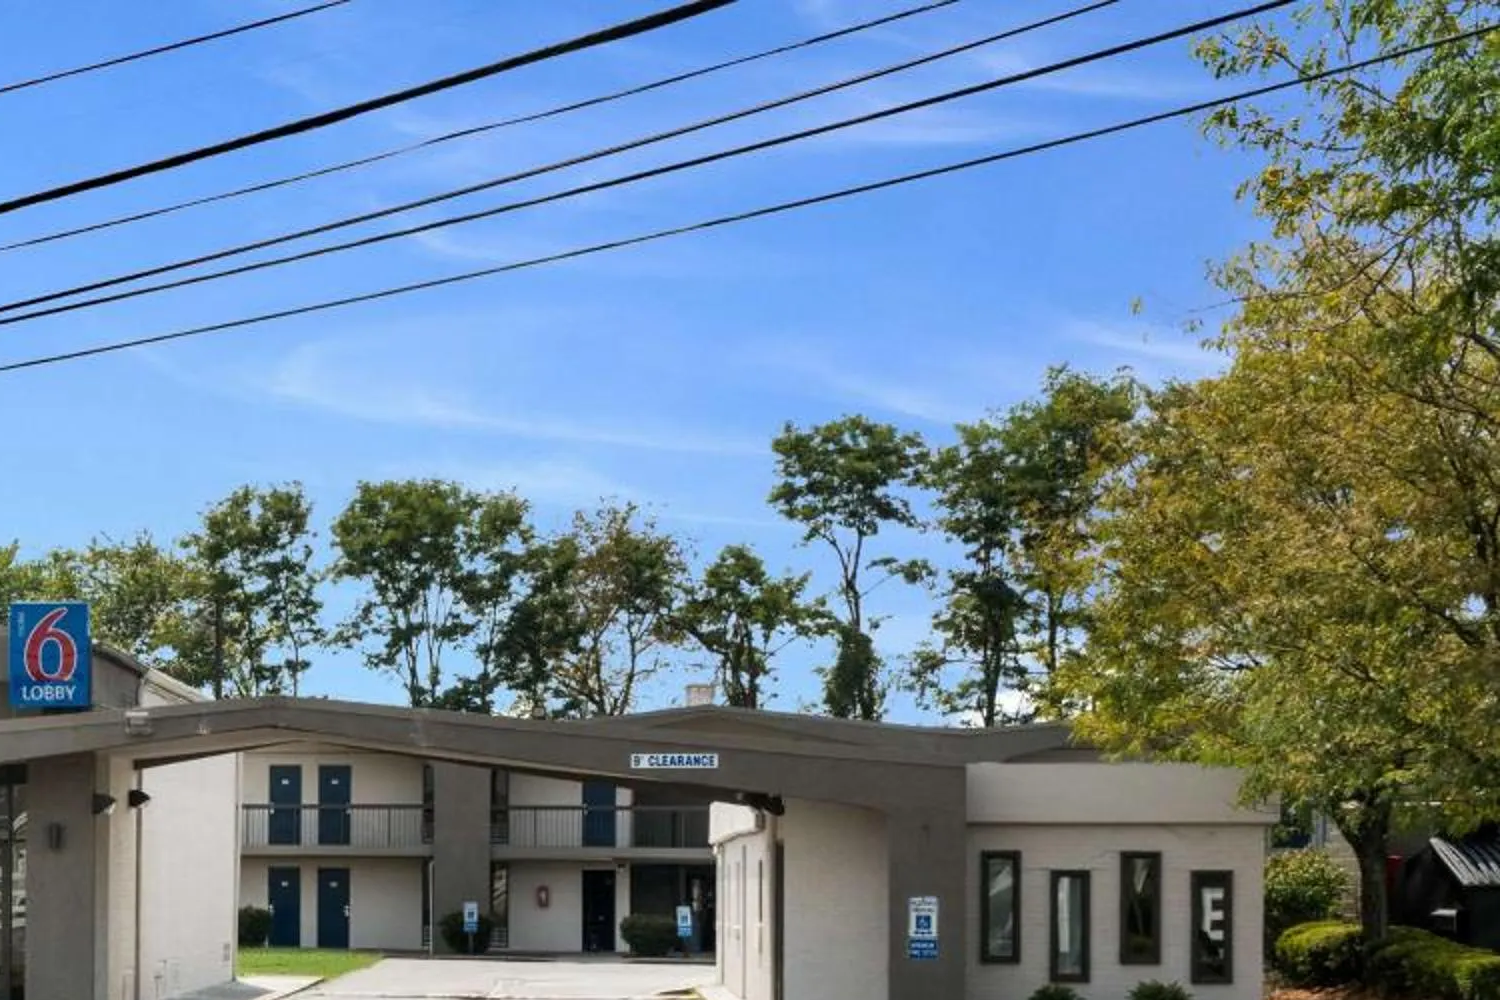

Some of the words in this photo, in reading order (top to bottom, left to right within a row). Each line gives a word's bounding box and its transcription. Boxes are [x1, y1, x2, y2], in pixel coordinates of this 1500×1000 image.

[23, 607, 77, 682] 6
[22, 685, 76, 701] LOBBY
[647, 755, 715, 767] CLEARANCE
